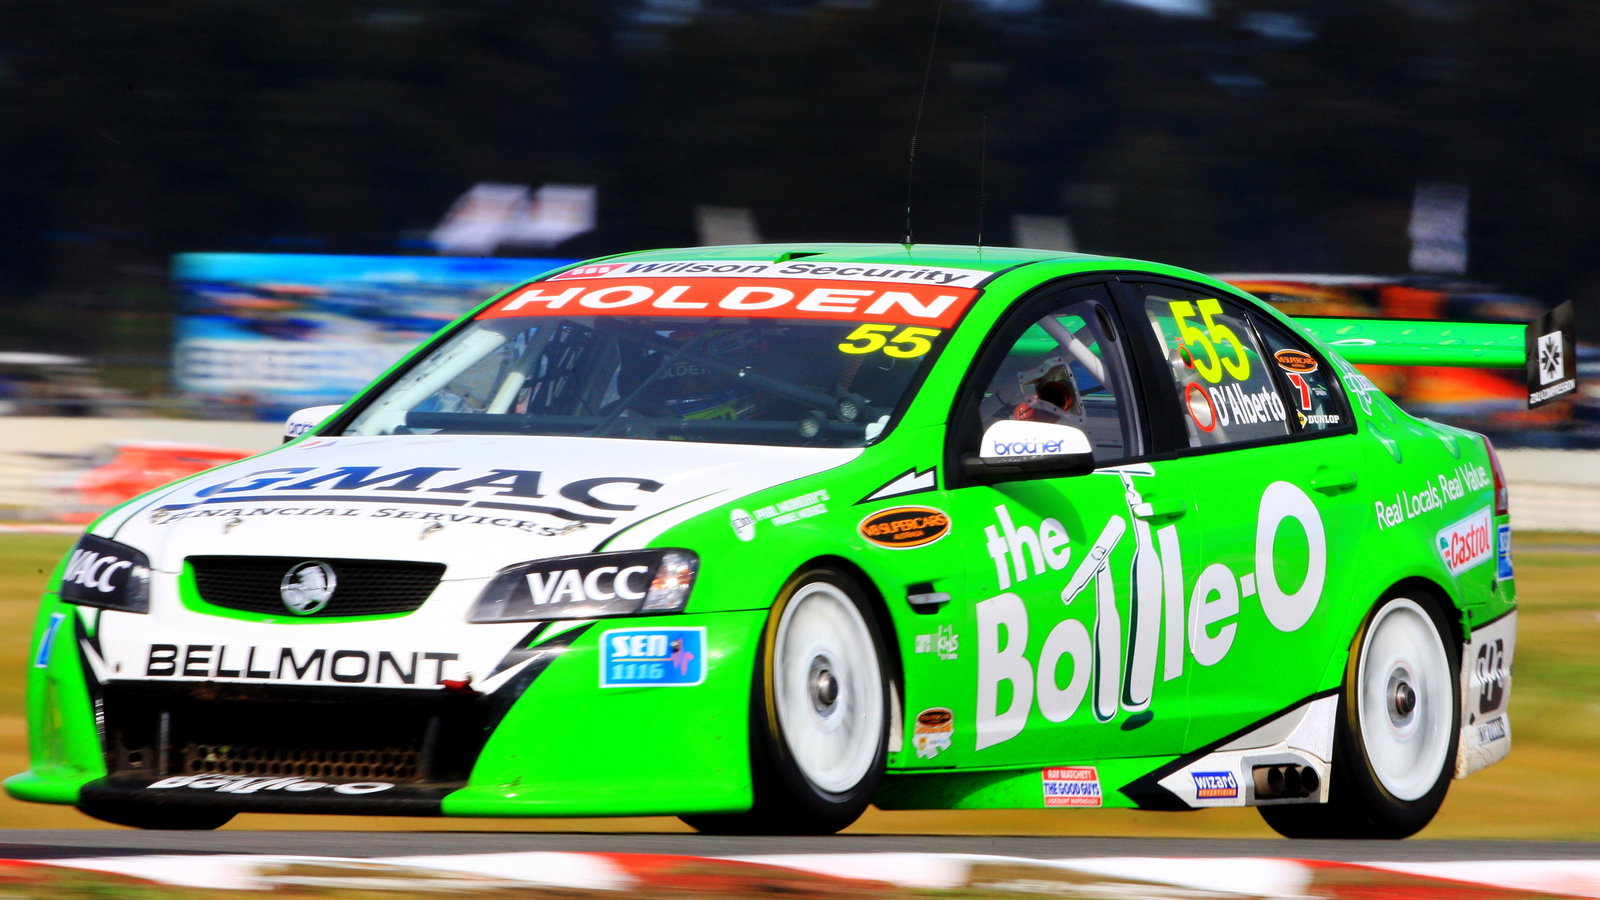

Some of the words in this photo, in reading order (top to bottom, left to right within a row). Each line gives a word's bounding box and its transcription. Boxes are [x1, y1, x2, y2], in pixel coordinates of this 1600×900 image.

[625, 262, 765, 278] Wilson
[779, 262, 968, 286] Security
[500, 284, 960, 319] HOLDEN
[837, 323, 943, 359] 55
[1168, 298, 1251, 384] 55
[1208, 382, 1286, 427] D'Alberto
[1307, 414, 1340, 424] DUNLOP
[194, 465, 666, 512] GMAC
[1374, 493, 1405, 531] Real
[1402, 480, 1443, 520] Locals,
[1438, 468, 1465, 504] Real
[1458, 462, 1491, 493] Value.
[163, 505, 378, 526] FINANCIAL
[380, 506, 559, 538] SERVICES
[1450, 516, 1491, 569] Castrol
[983, 503, 1072, 592] the
[62, 548, 134, 593] VACC
[525, 564, 649, 606] VACC
[975, 464, 1328, 753] Bottle-O
[146, 642, 460, 686] BELLMONT
[610, 634, 669, 658] SEN
[610, 662, 666, 680] 1116
[1043, 782, 1058, 795] THE
[1058, 782, 1081, 795] GOOD
[1194, 771, 1237, 789] wizard
